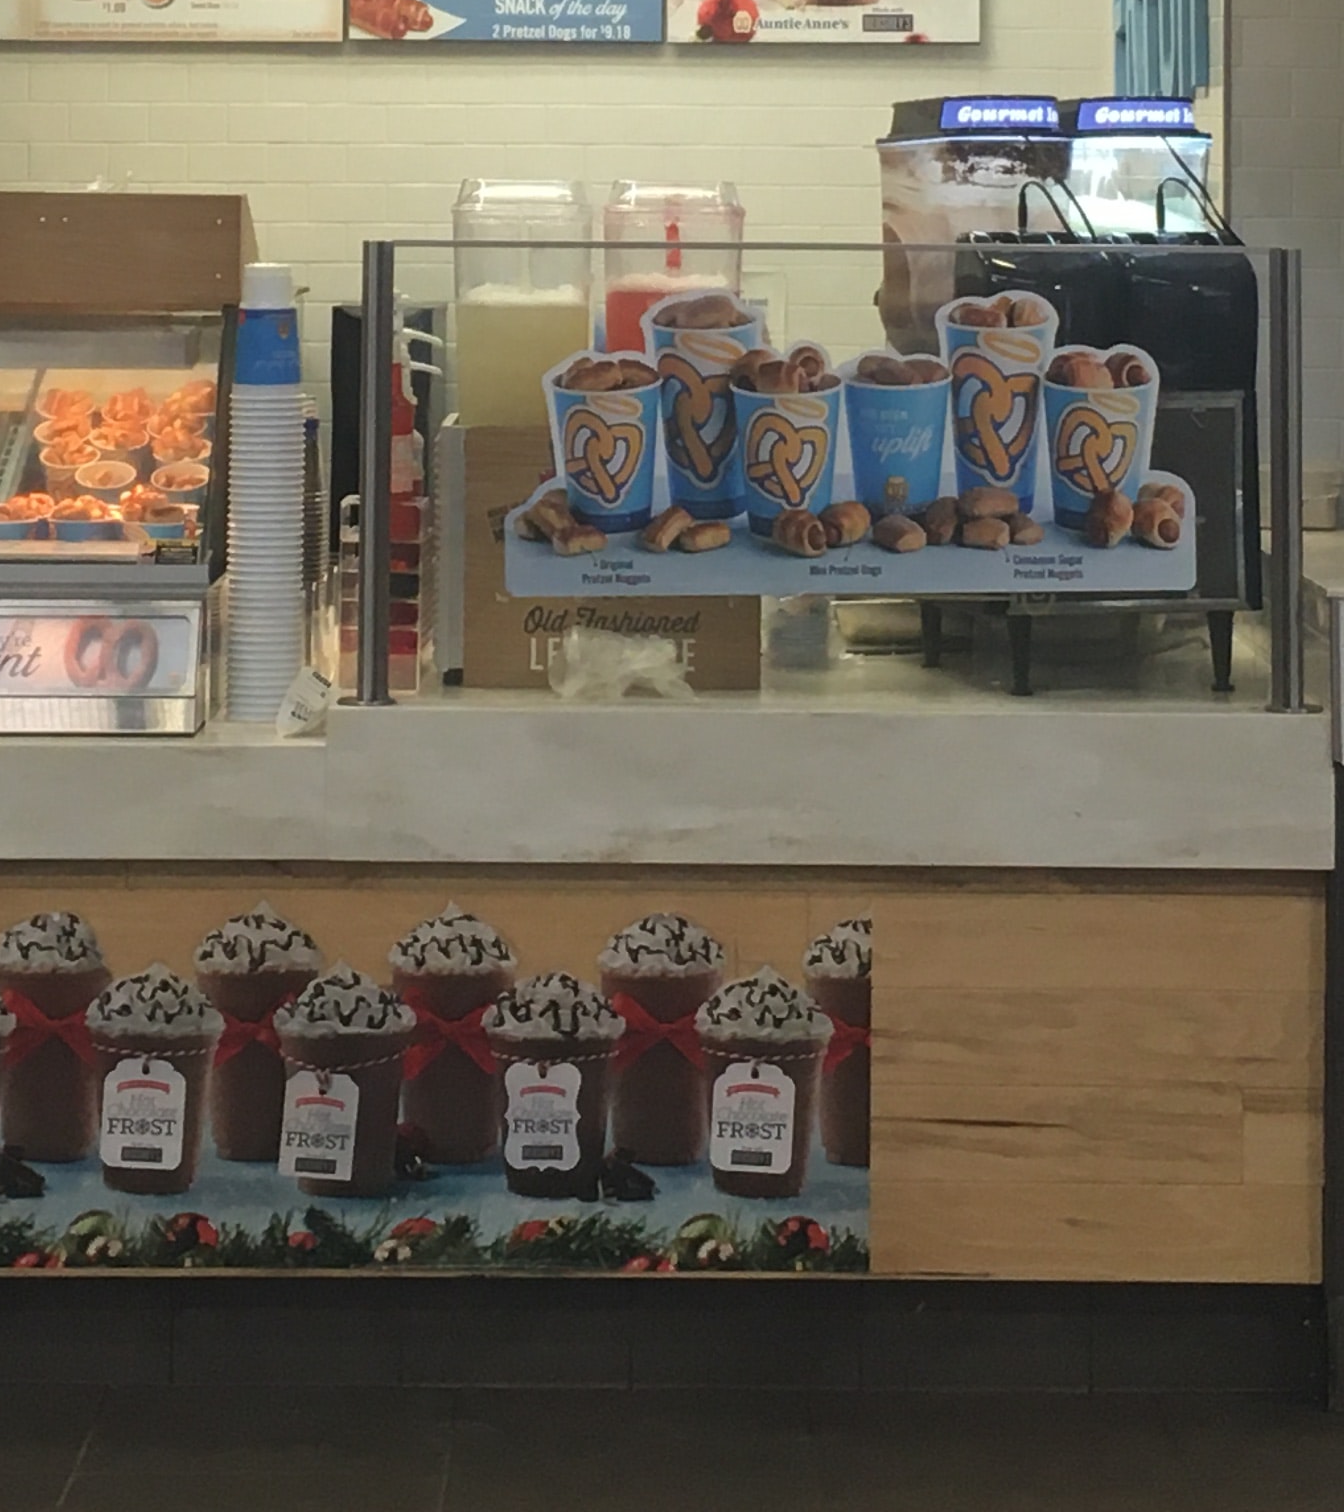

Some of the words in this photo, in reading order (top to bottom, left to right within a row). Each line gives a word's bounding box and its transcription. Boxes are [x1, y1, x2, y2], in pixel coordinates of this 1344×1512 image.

[492, 25, 500, 38] 2
[502, 25, 545, 39] Pretzel
[548, 26, 577, 41] Dogs
[580, 25, 598, 39] for
[957, 105, 1044, 123] Gourmet
[1094, 106, 1181, 124] Gourmet
[523, 606, 569, 635] Old
